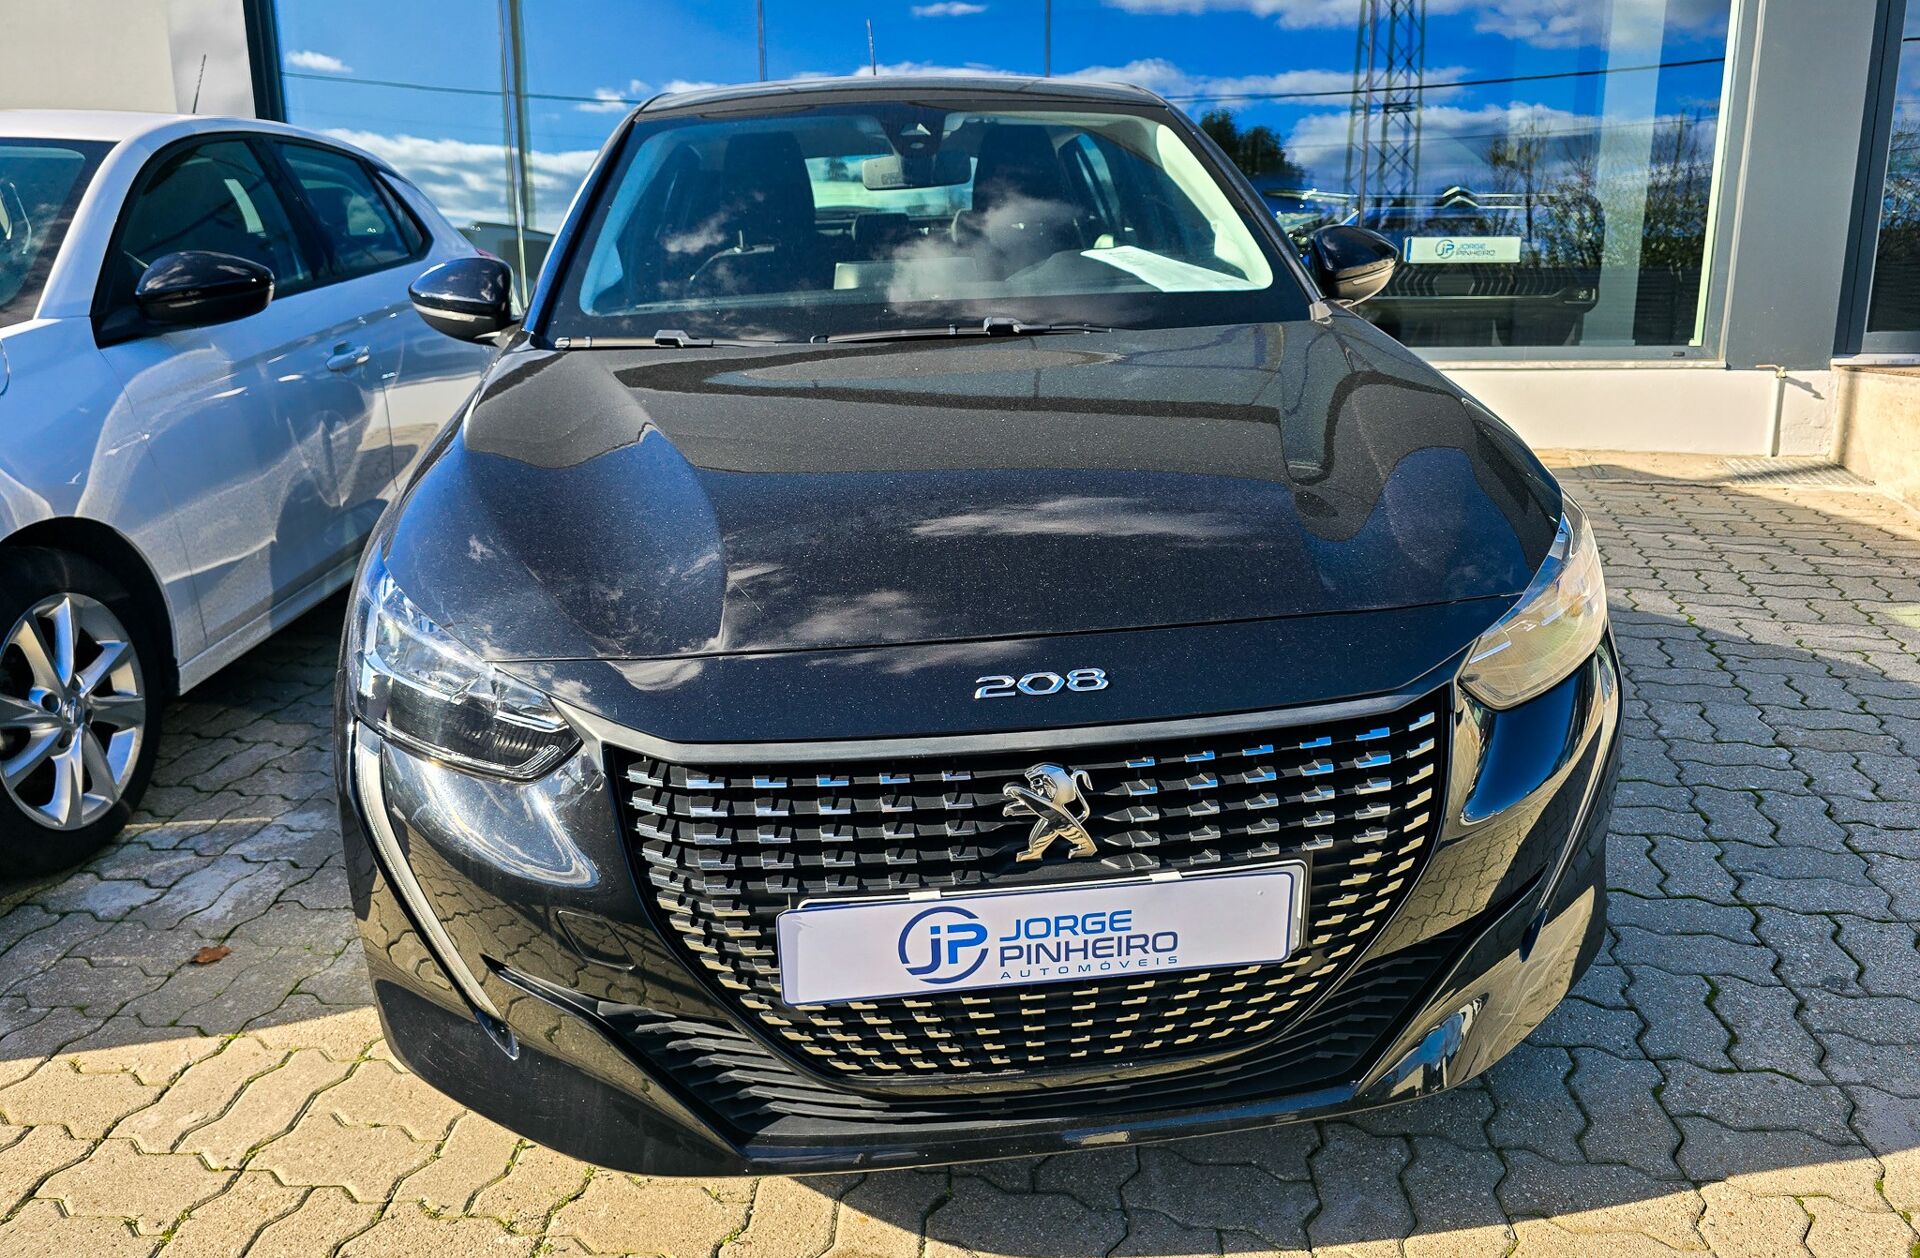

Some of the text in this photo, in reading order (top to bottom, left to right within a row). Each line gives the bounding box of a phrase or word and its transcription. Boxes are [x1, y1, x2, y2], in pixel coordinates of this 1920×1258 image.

[974, 667, 1109, 699] 208
[1000, 910, 1132, 942] JORGE
[999, 931, 1178, 967] PINHEIRO
[1000, 955, 1178, 980] AUTOMÓVEIS
